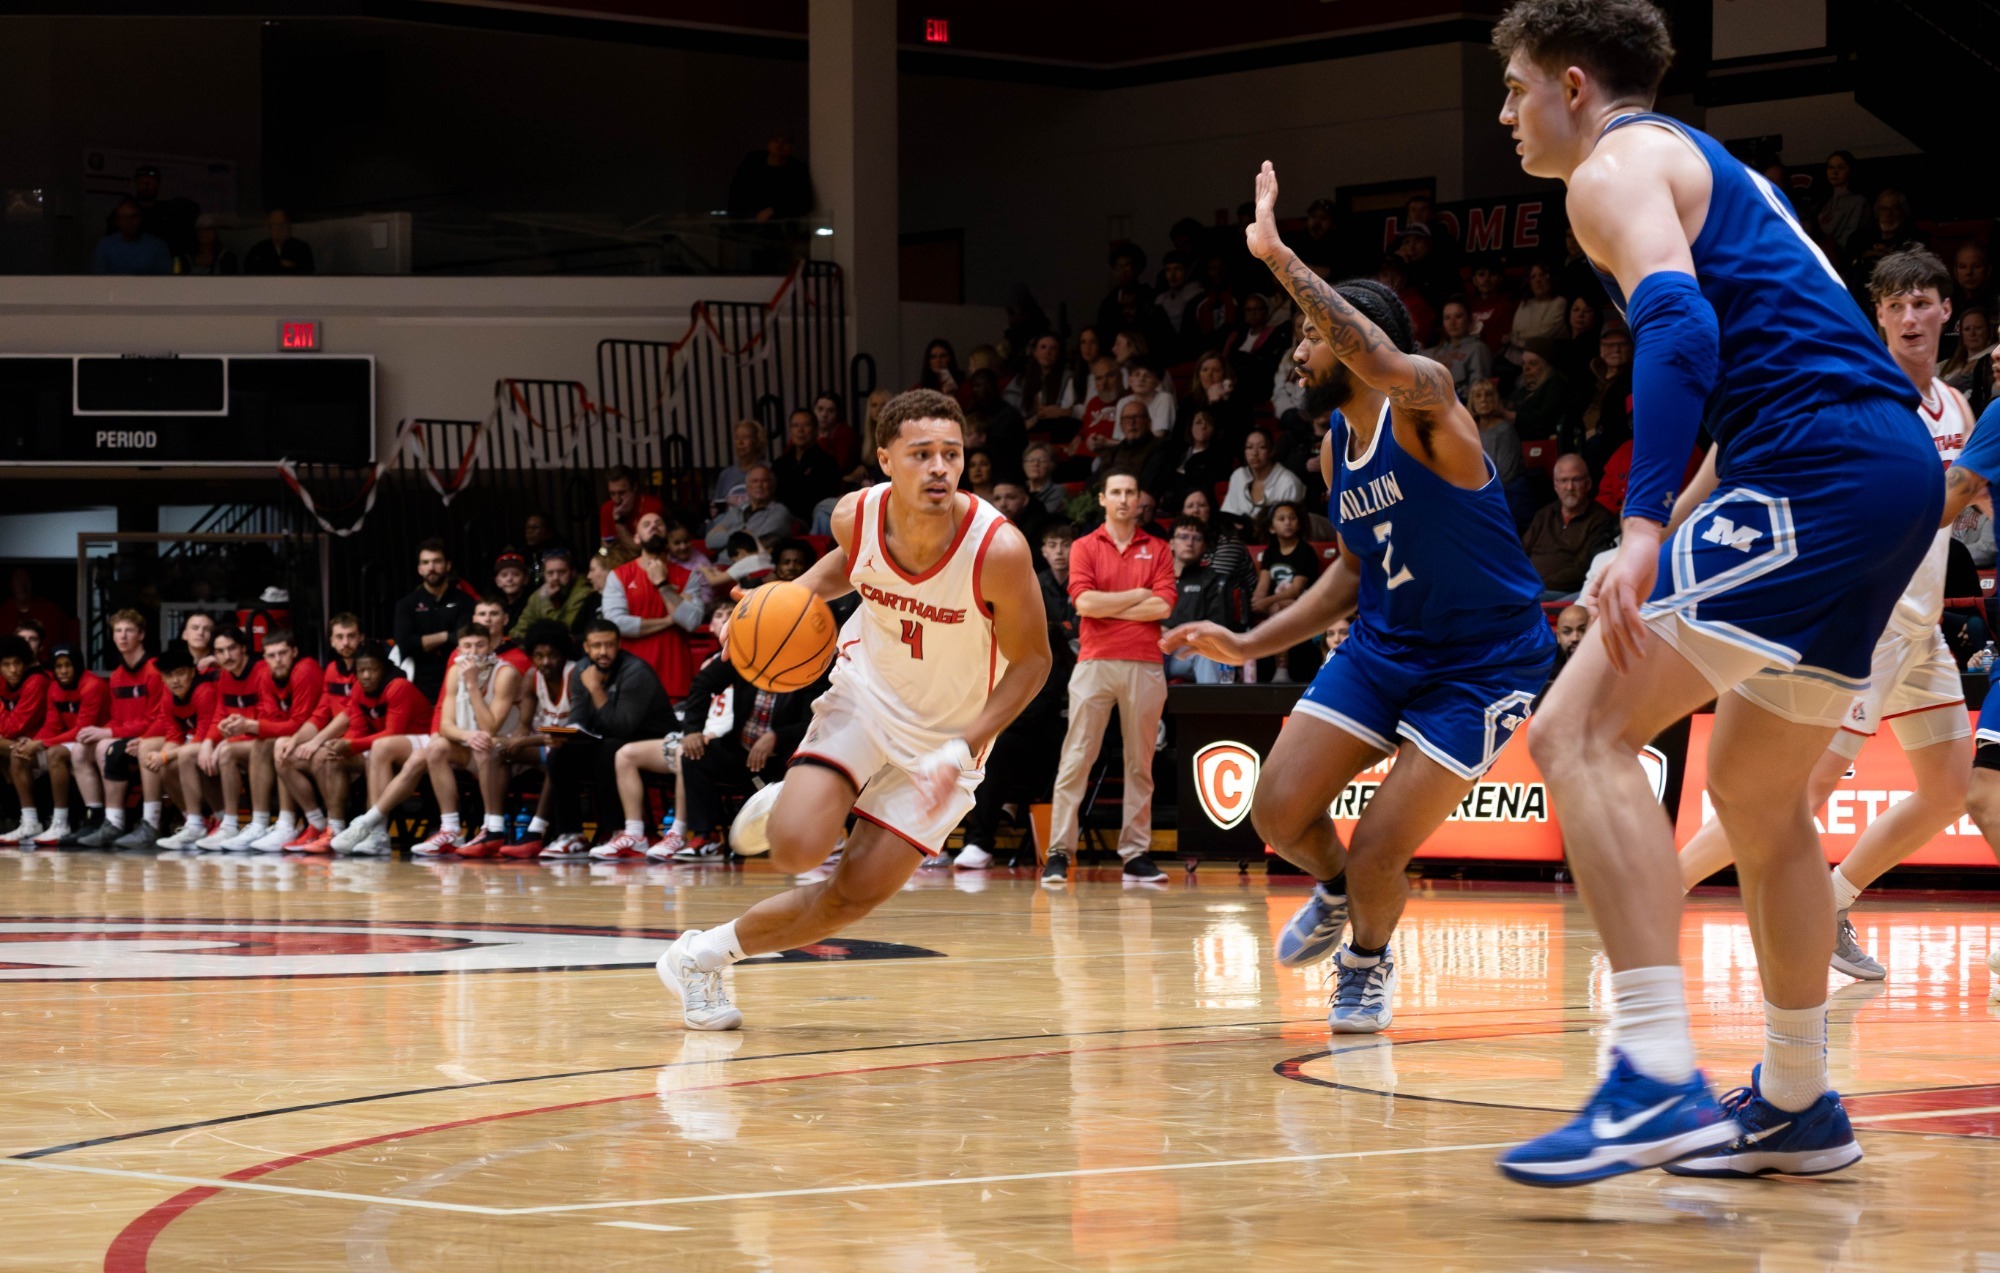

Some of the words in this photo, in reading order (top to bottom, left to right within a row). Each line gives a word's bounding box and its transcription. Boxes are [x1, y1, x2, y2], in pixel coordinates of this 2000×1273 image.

[926, 19, 948, 42] EXIT
[283, 322, 314, 348] EXIT
[96, 430, 157, 448] PERIOD
[1701, 515, 1763, 553] M
[1373, 521, 1416, 591] 2
[860, 583, 967, 624] CARTHAGE
[900, 619, 924, 661] 4
[1213, 759, 1243, 810] C
[1449, 785, 1547, 820] RENA
